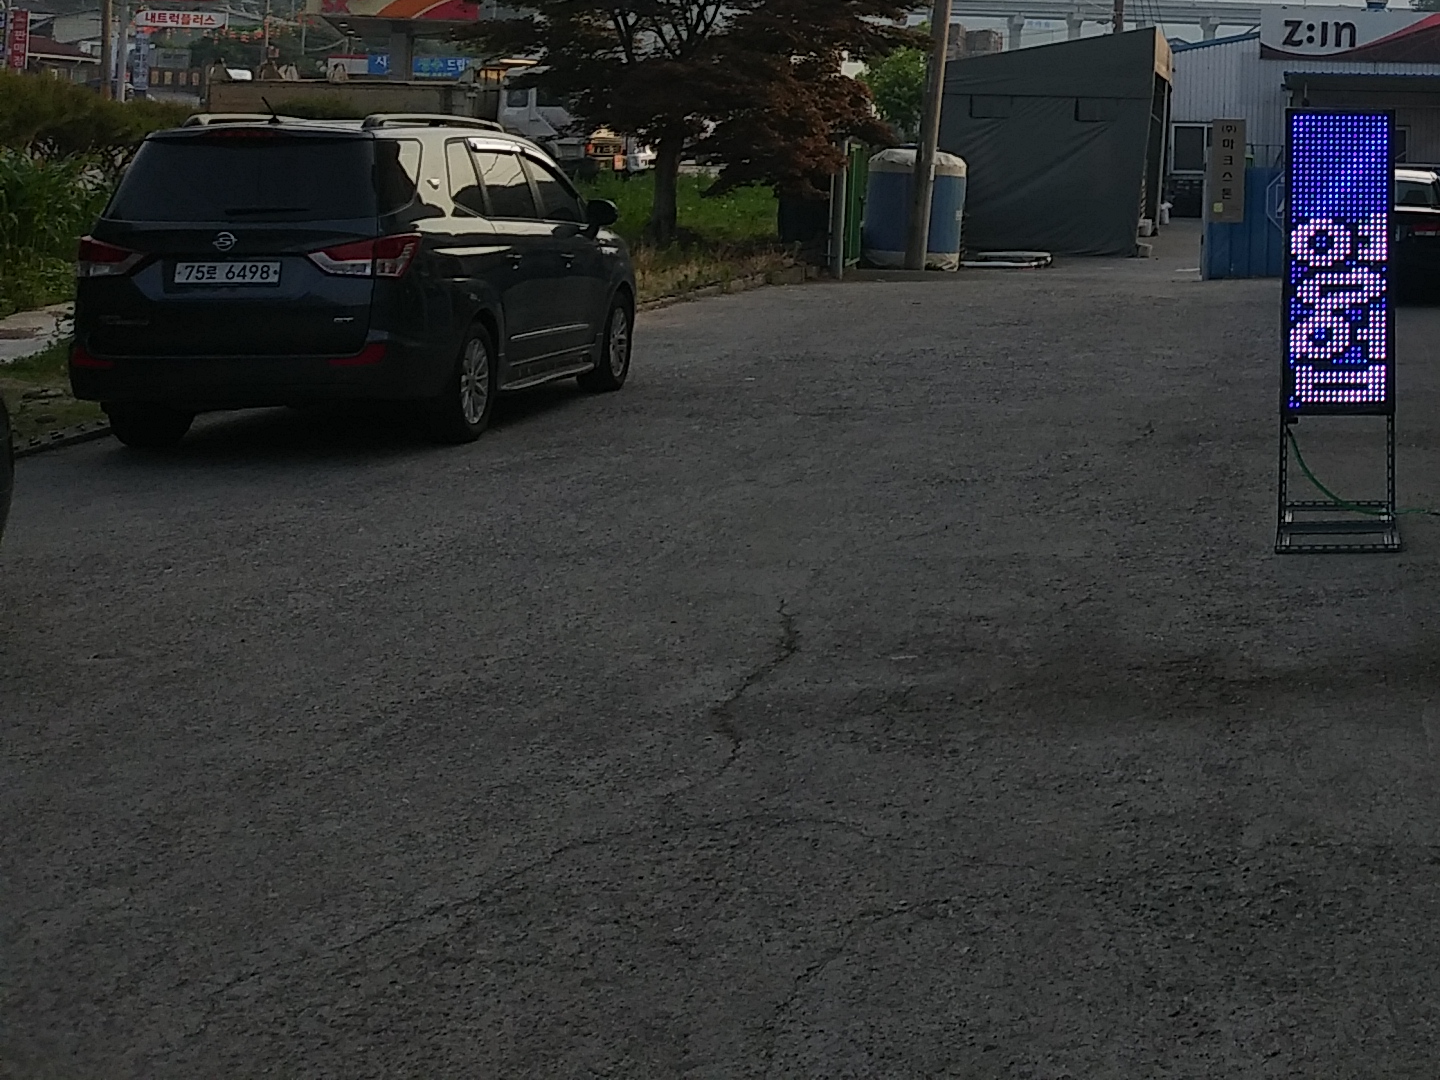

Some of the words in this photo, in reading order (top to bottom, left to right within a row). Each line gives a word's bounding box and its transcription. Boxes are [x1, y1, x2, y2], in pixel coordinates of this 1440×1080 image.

[145, 12, 216, 25] 내트럭플러스
[447, 58, 469, 72] 드립
[184, 265, 217, 281] 75로
[226, 264, 270, 281] 6498
